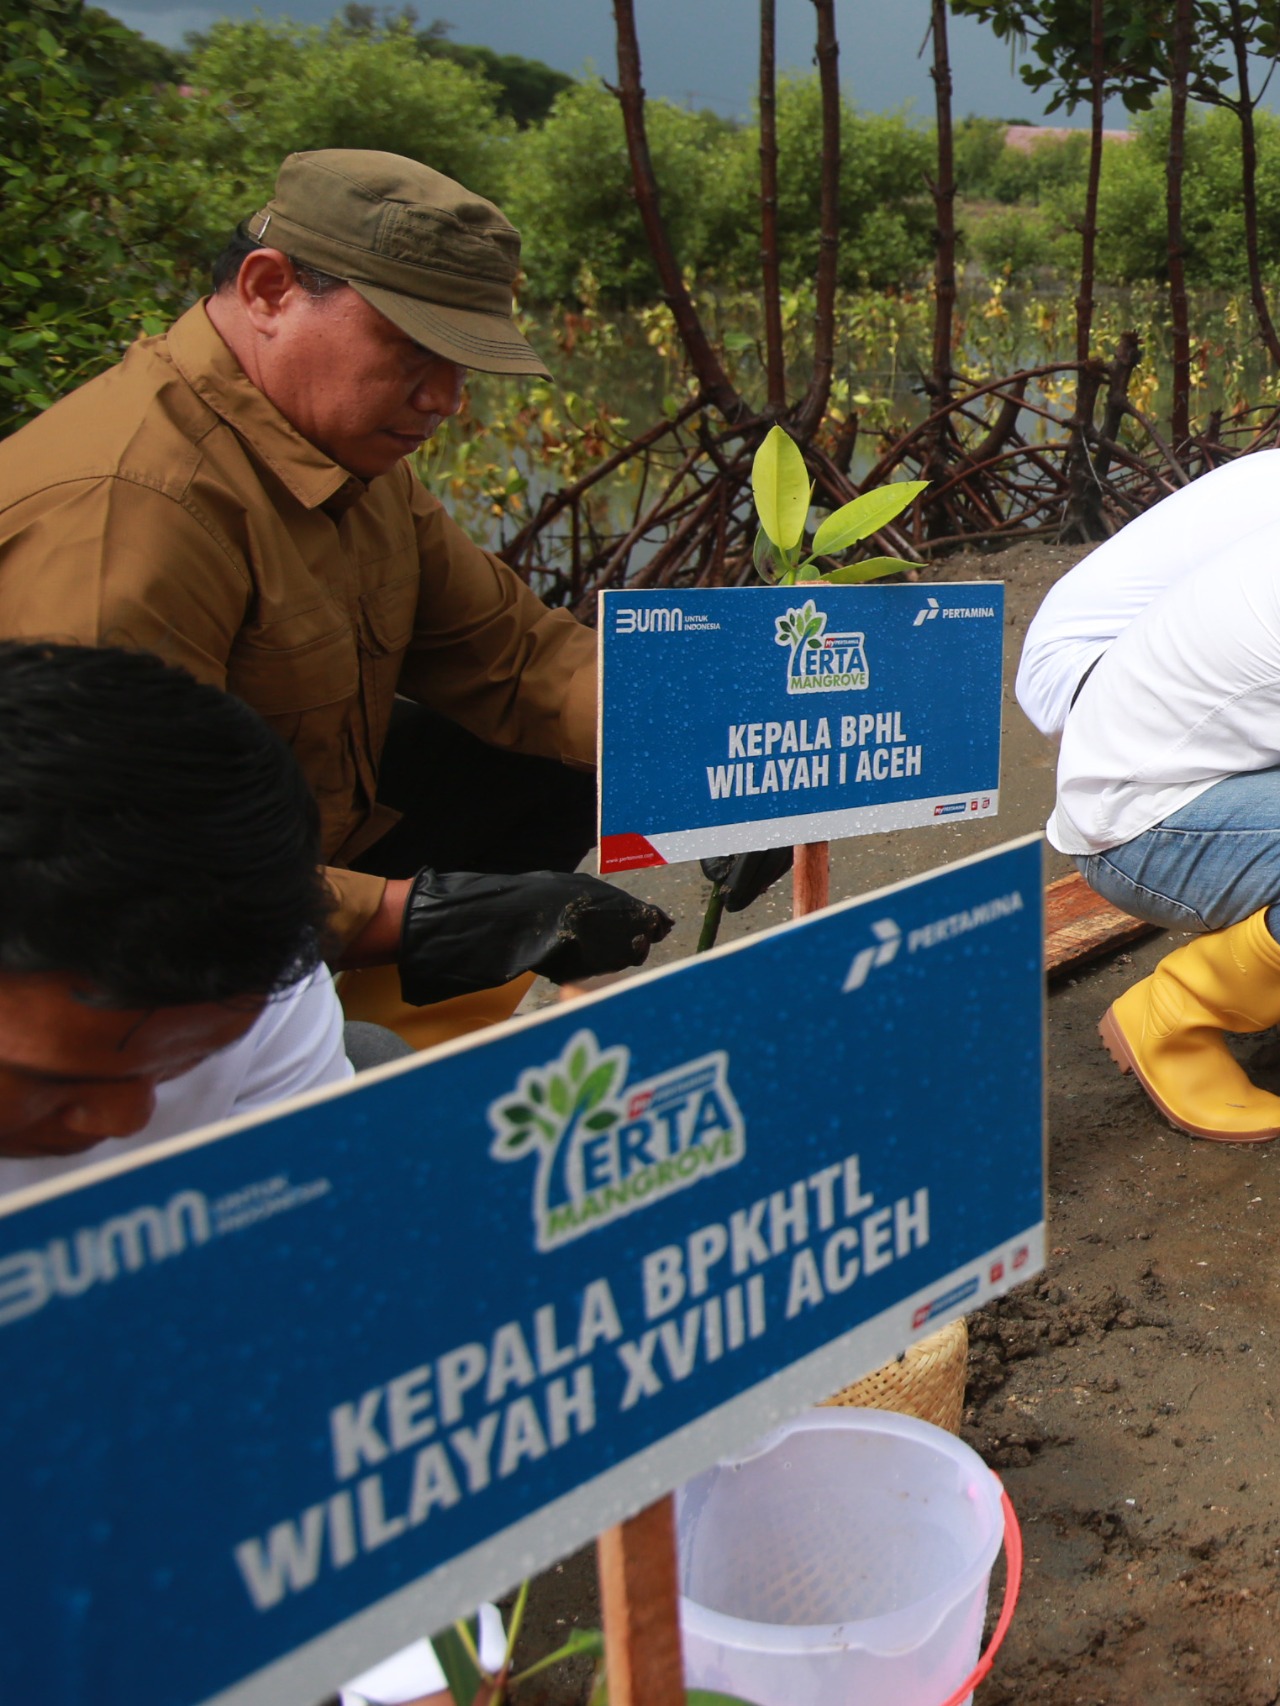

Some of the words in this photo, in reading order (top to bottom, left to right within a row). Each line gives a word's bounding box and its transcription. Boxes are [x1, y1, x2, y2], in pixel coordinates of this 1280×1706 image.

[684, 623, 720, 631] INDONESIA
[942, 607, 995, 619] PERTAMINA
[791, 673, 865, 690] MANGROVE
[728, 717, 832, 759] KEPALA
[840, 711, 907, 748] BPHL
[706, 754, 830, 800] WILAYAH
[839, 752, 847, 785] I
[855, 745, 922, 783] ACEH
[907, 890, 1024, 954] PERTAMINA
[547, 1128, 735, 1240] MANGROVE
[329, 1276, 624, 1483] KEPALA
[641, 1153, 874, 1320] BPKHTL
[234, 1364, 598, 1612] WILAYAH
[617, 1273, 767, 1412] XVIII
[784, 1188, 930, 1319] ACEH
